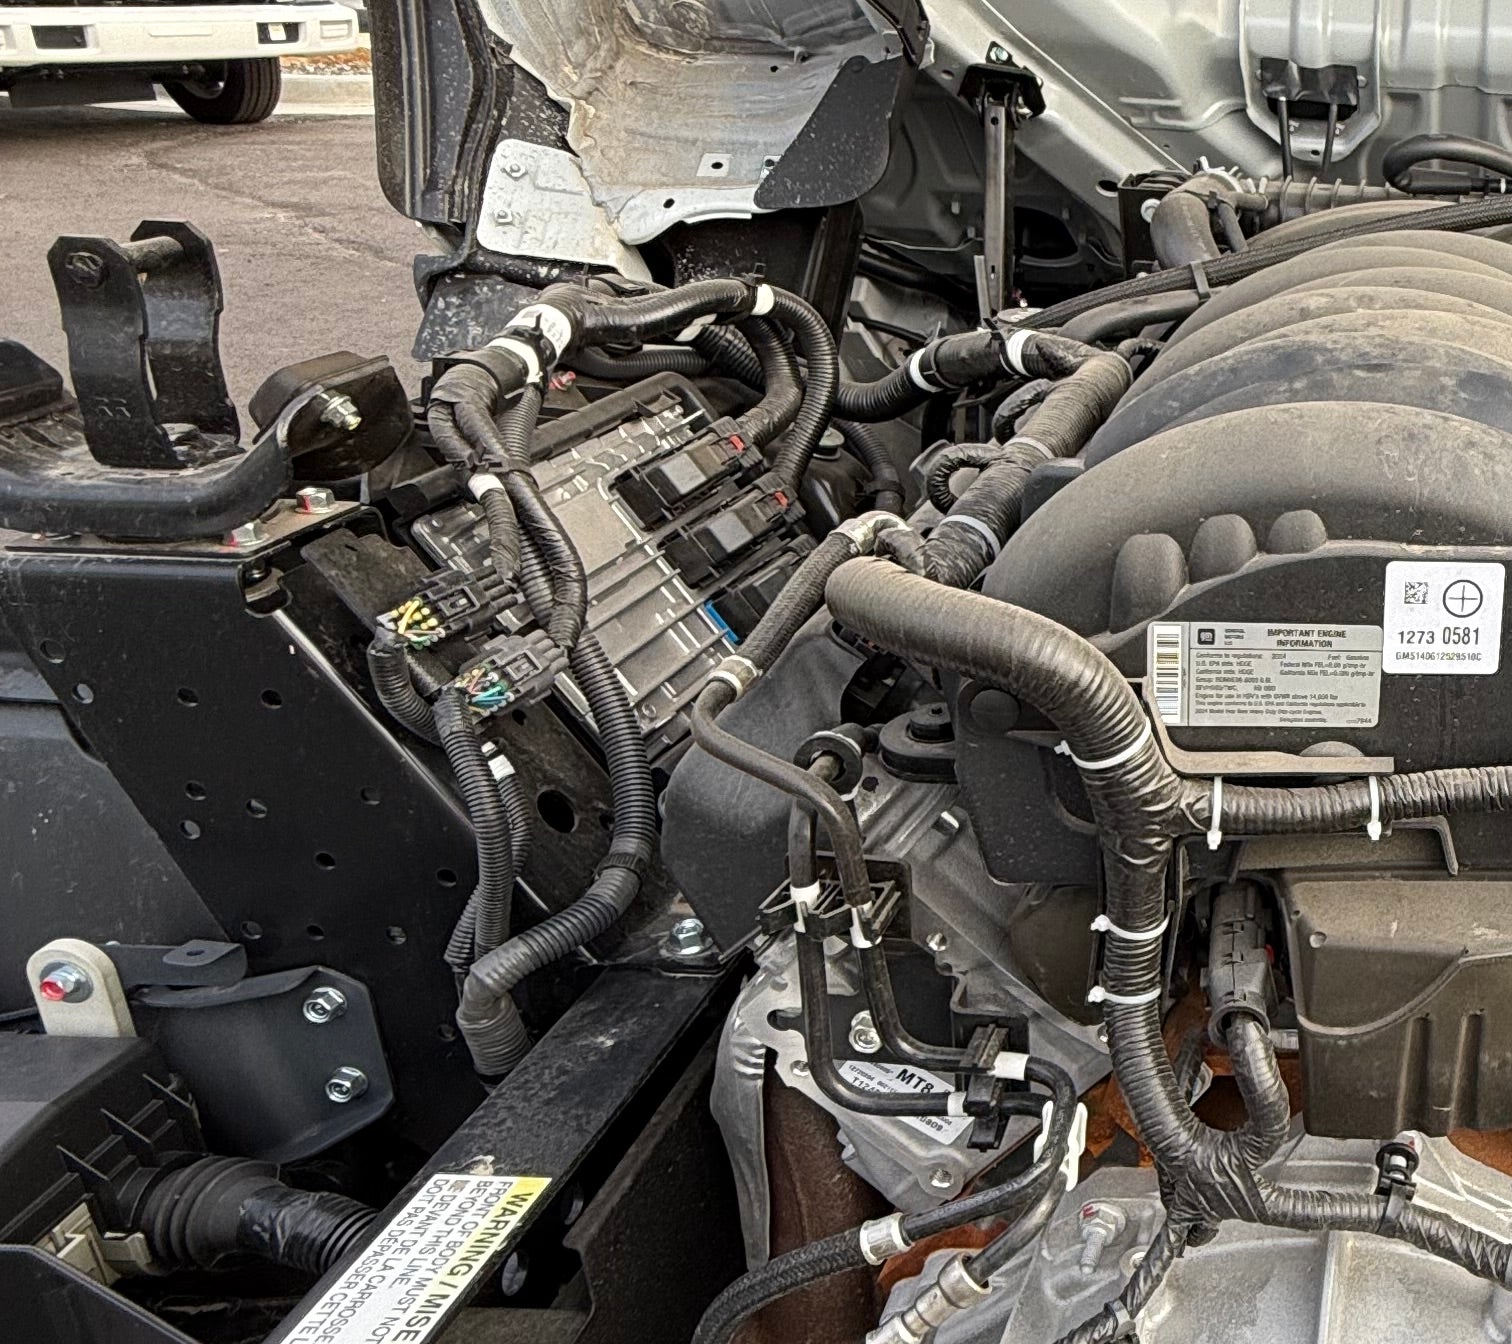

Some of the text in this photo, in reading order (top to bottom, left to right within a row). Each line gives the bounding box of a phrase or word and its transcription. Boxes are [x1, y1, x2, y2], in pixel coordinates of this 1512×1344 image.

[1267, 628, 1347, 638] IMPORTANT ENGINE
[1277, 639, 1333, 648] INFORMATION
[1398, 626, 1479, 645] 1273 0581
[896, 1068, 935, 1094] MT8
[419, 1179, 450, 1204] DOIT
[472, 1182, 513, 1219] FRONT
[396, 1207, 426, 1226] PAS
[410, 1195, 457, 1237] DEVANT
[389, 1181, 494, 1288] BEYOND THIS LINE.
[447, 1192, 534, 1276] WARNING
[458, 1221, 479, 1238] OF
[339, 1230, 406, 1289] DÉPASSER
[392, 1240, 418, 1255] DE
[426, 1241, 464, 1274] BODY
[377, 1258, 402, 1272] LA
[392, 1278, 433, 1313] MUST
[439, 1281, 458, 1289] /
[300, 1293, 348, 1333] CETTE
[392, 1294, 450, 1341] MISE
[366, 1317, 400, 1344] NOT
